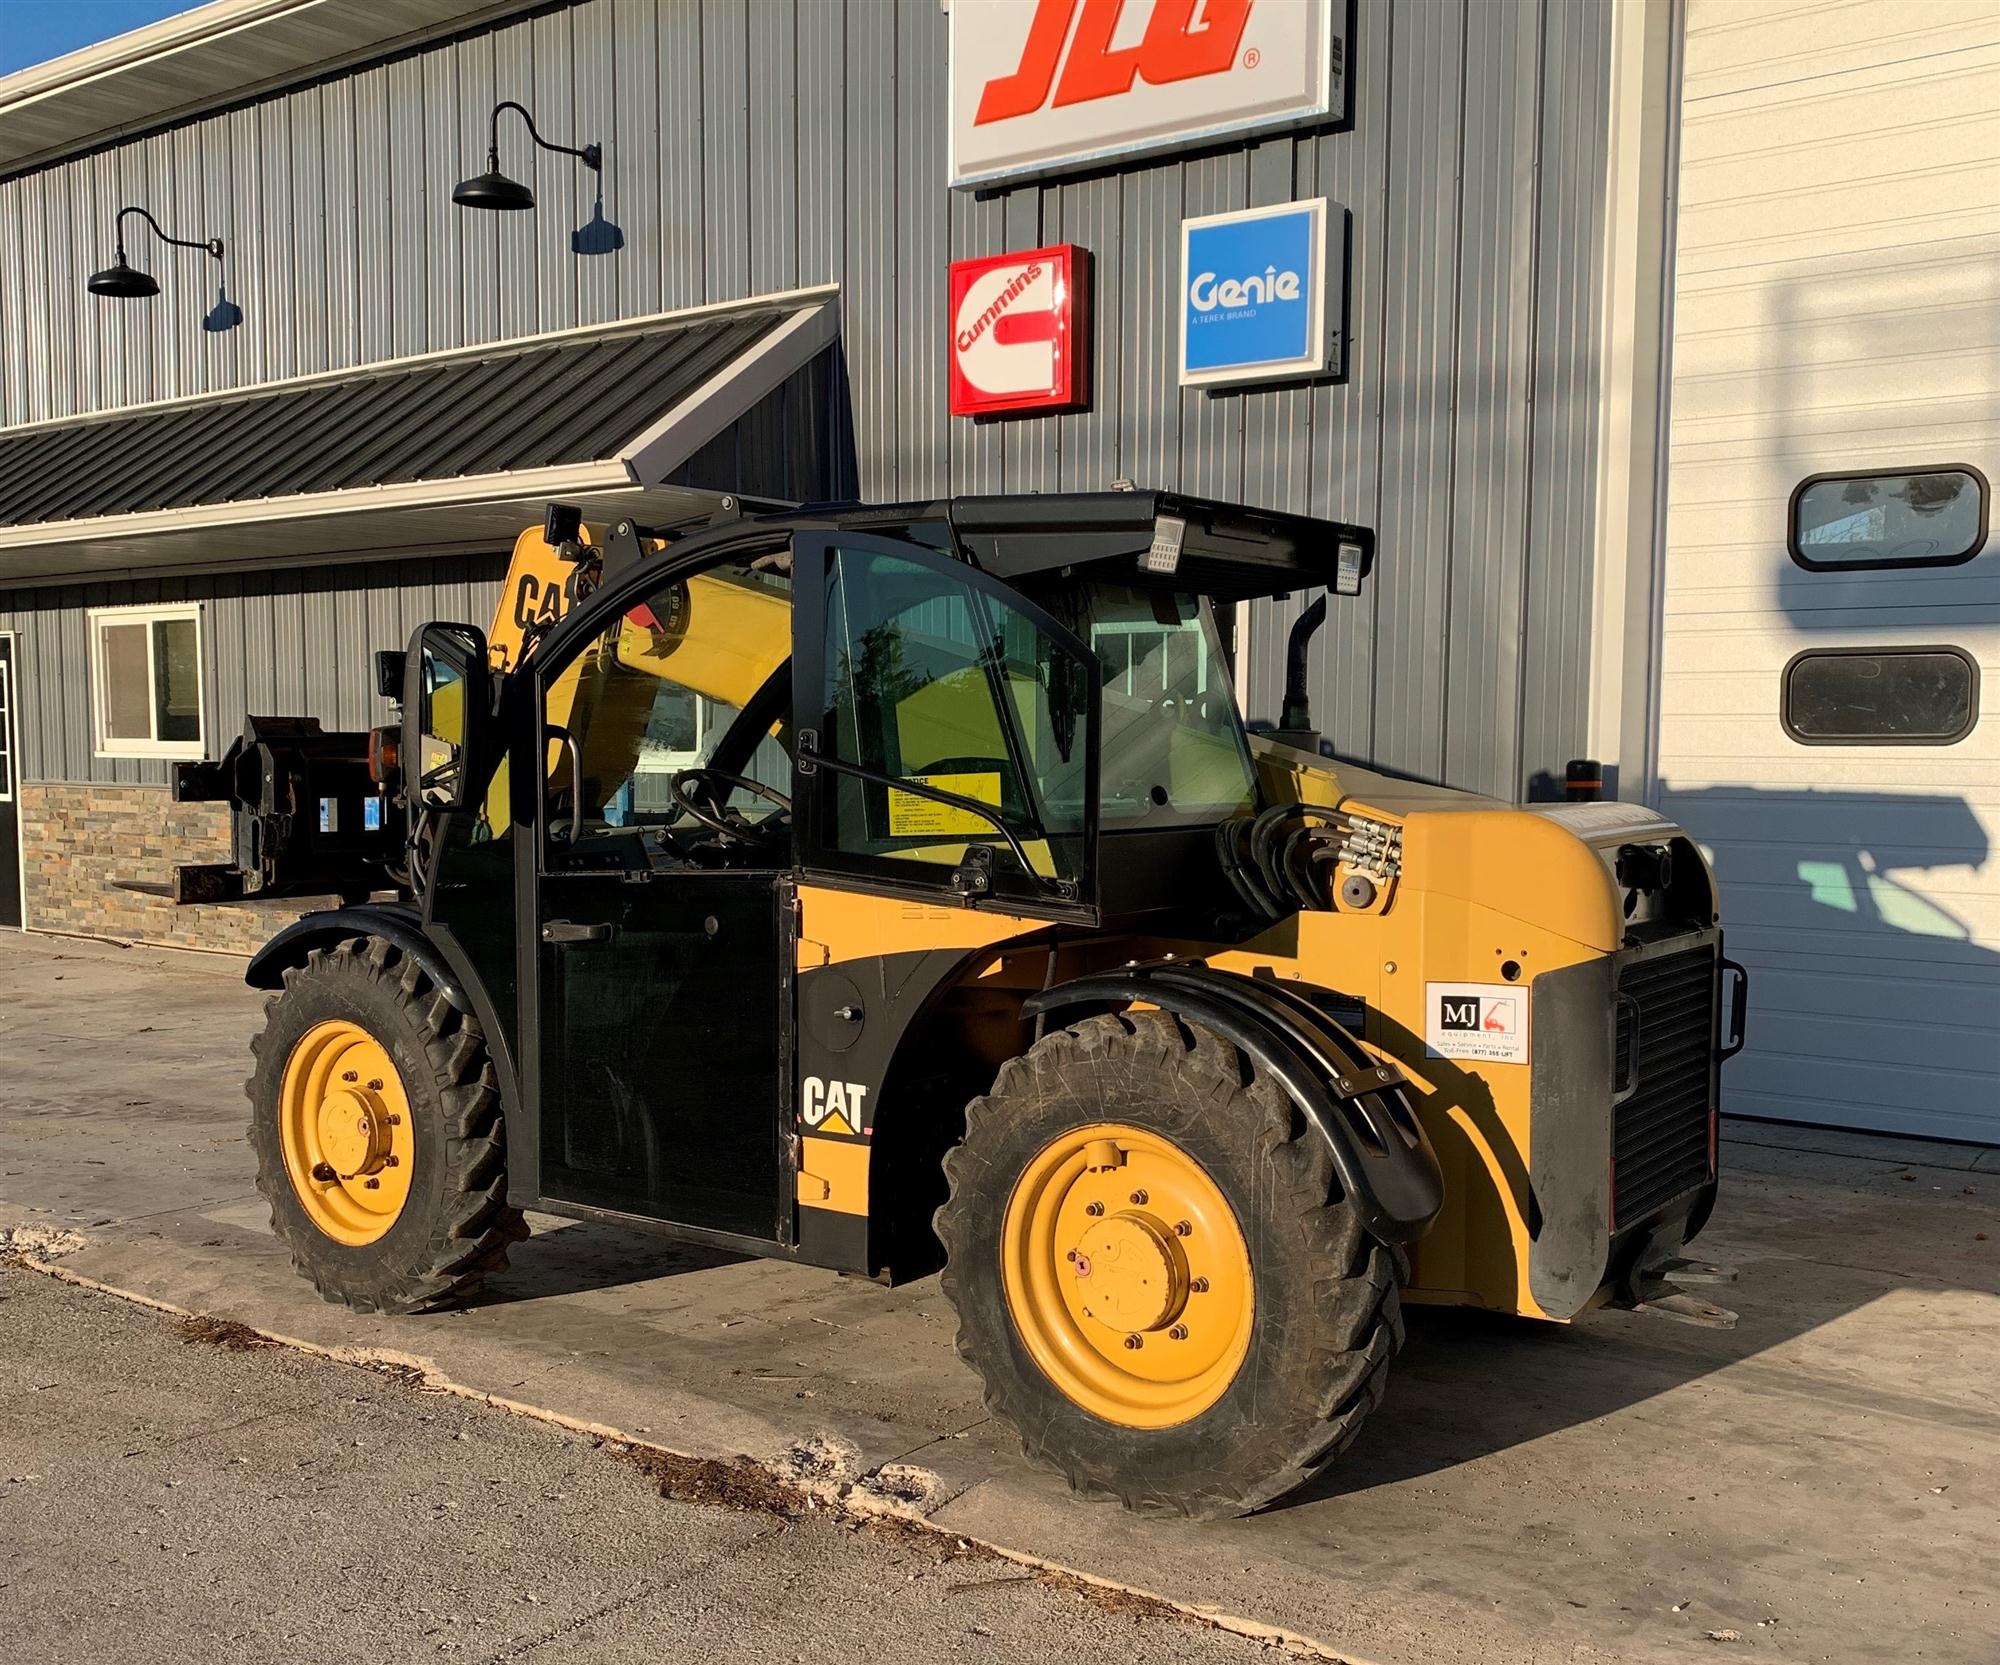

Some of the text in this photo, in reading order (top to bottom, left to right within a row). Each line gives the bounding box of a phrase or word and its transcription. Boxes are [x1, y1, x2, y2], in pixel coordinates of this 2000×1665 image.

[973, 0, 1252, 127] JLG
[957, 263, 1042, 353] Cummins
[1190, 264, 1300, 312] Genie
[1200, 313, 1225, 324] TEREX
[1227, 309, 1257, 321] BRAND
[1443, 1003, 1477, 1027] MJ
[803, 1076, 867, 1134] CAT
